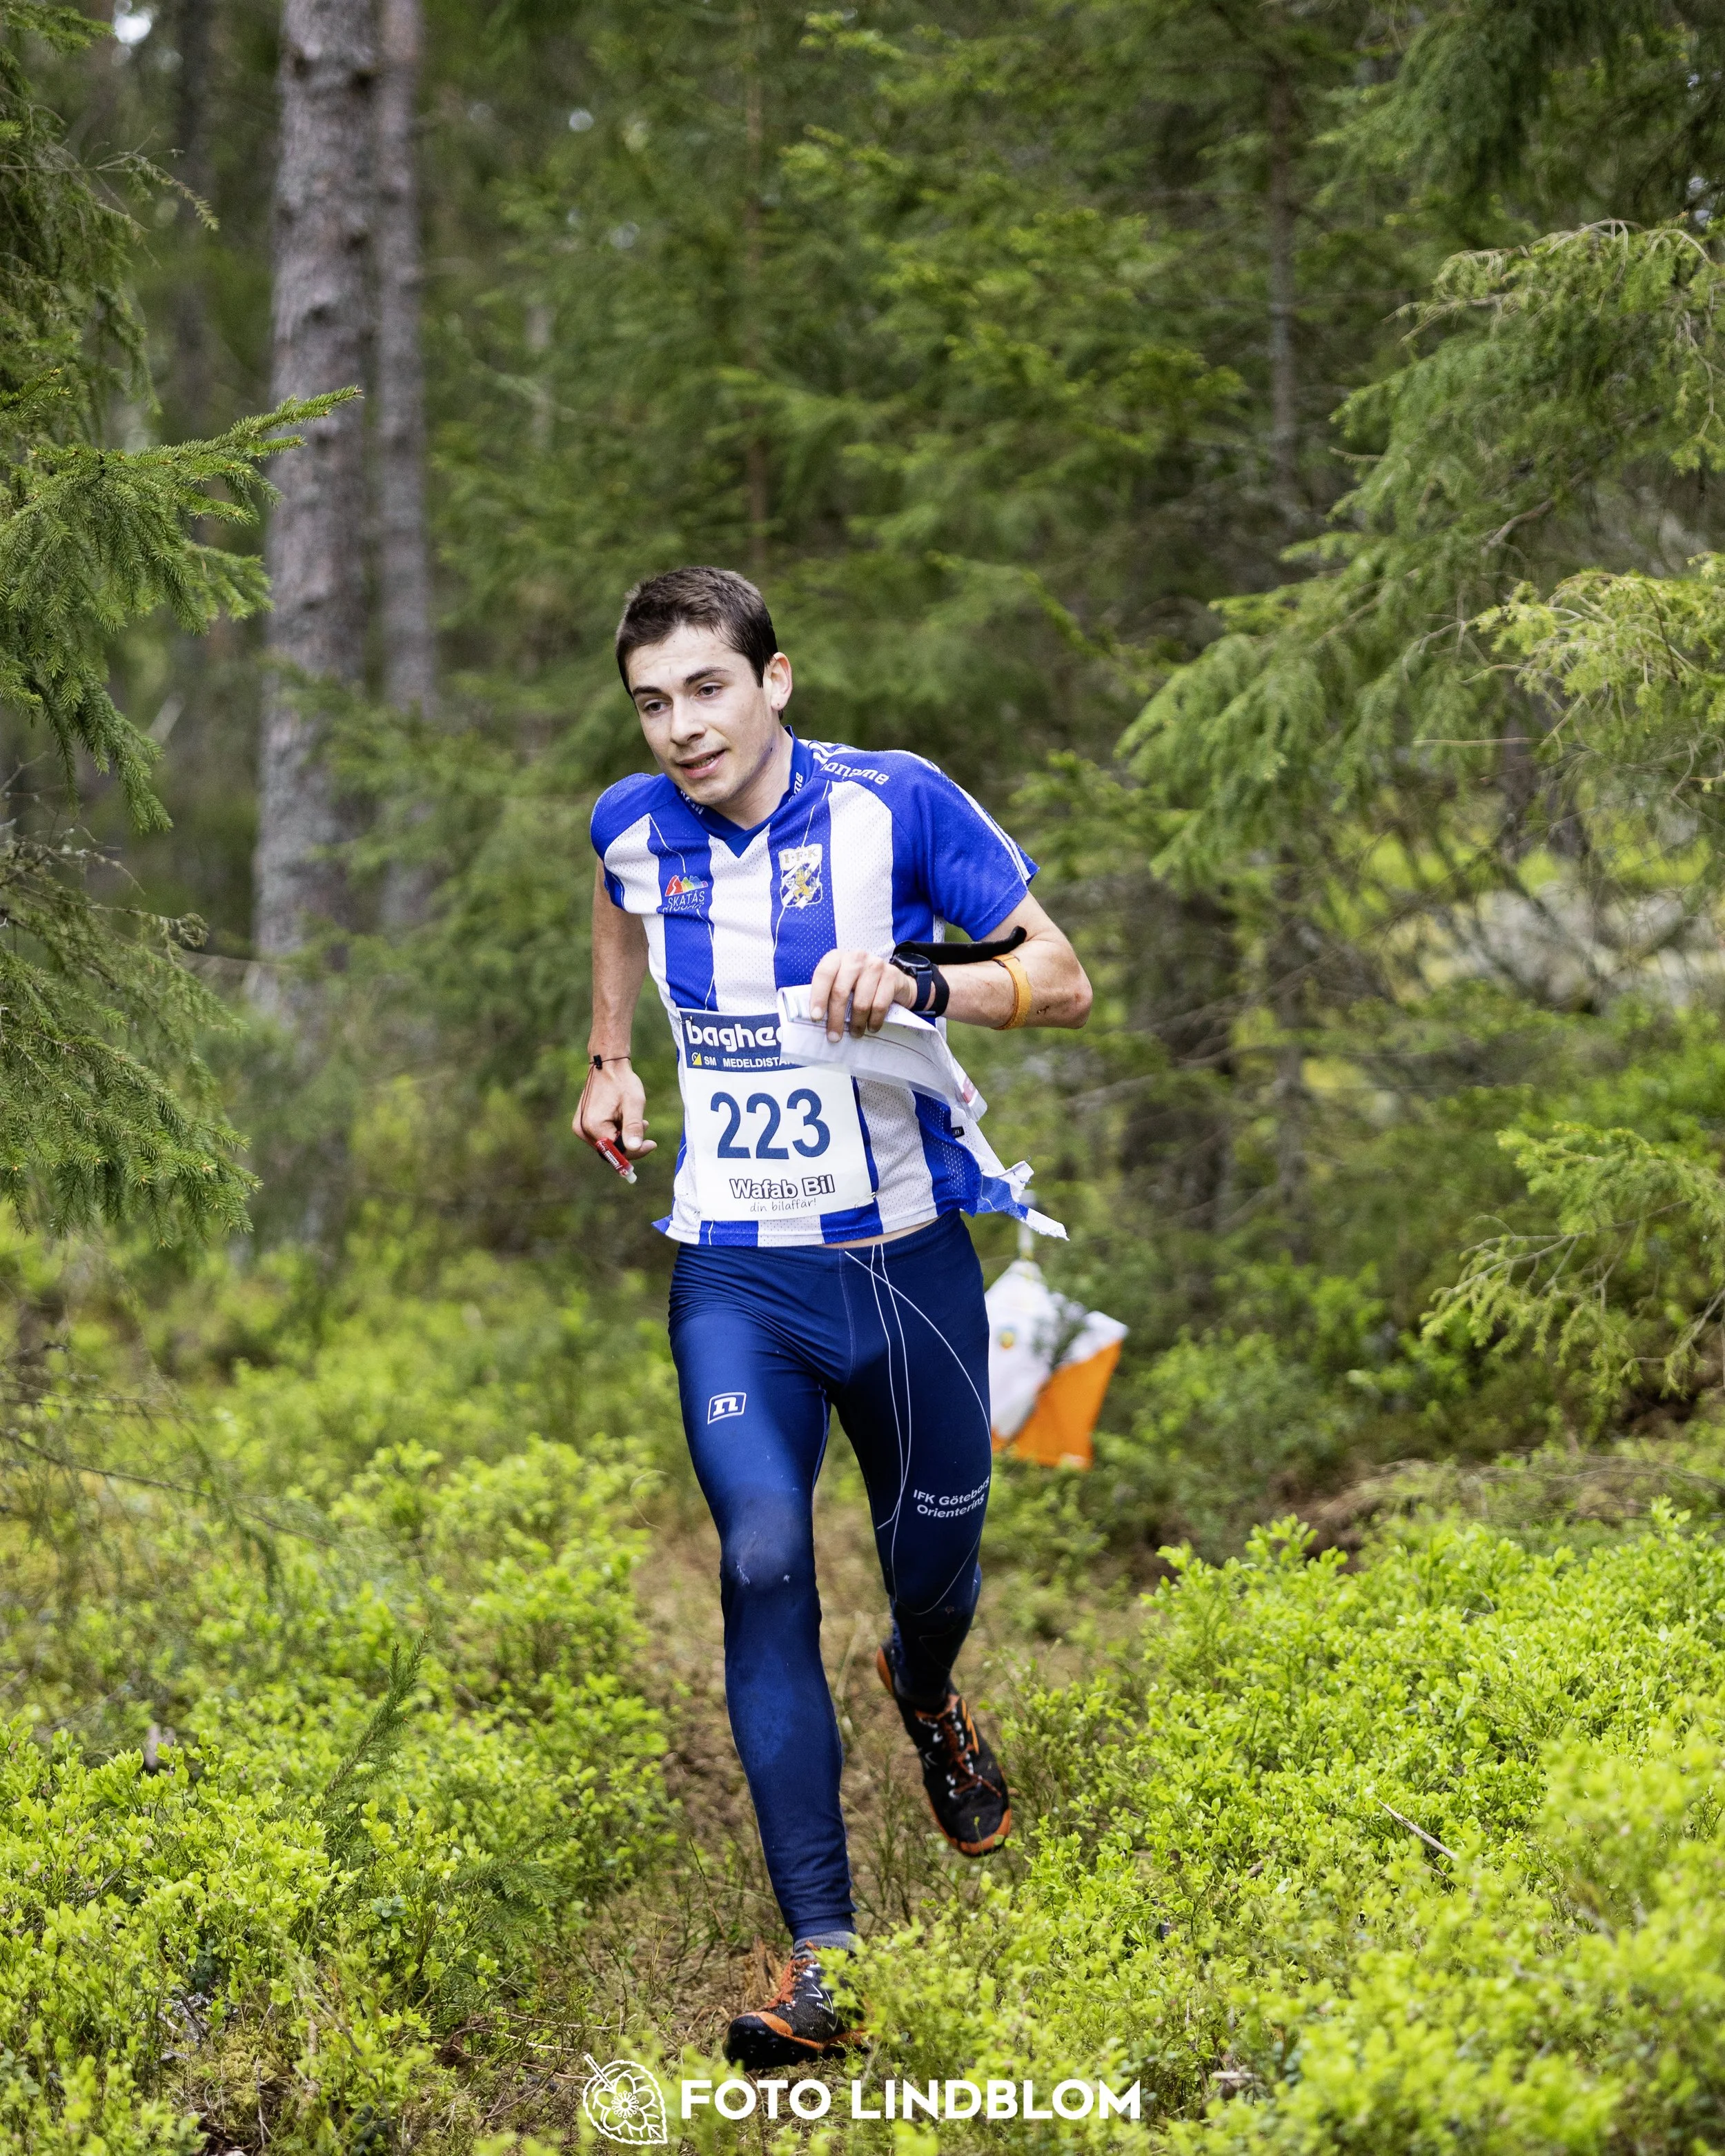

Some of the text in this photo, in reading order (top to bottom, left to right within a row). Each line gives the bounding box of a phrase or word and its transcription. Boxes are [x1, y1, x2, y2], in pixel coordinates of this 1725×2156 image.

[668, 890, 705, 908] SKATÅS
[704, 1056, 791, 1068] SM MEDELDISTA
[711, 1088, 830, 1159] 223
[729, 1174, 835, 1198] Wafab Bil
[750, 1198, 816, 1212] din bilaffär!
[913, 1489, 936, 1504] IFK
[917, 1493, 985, 1518] Orientering
